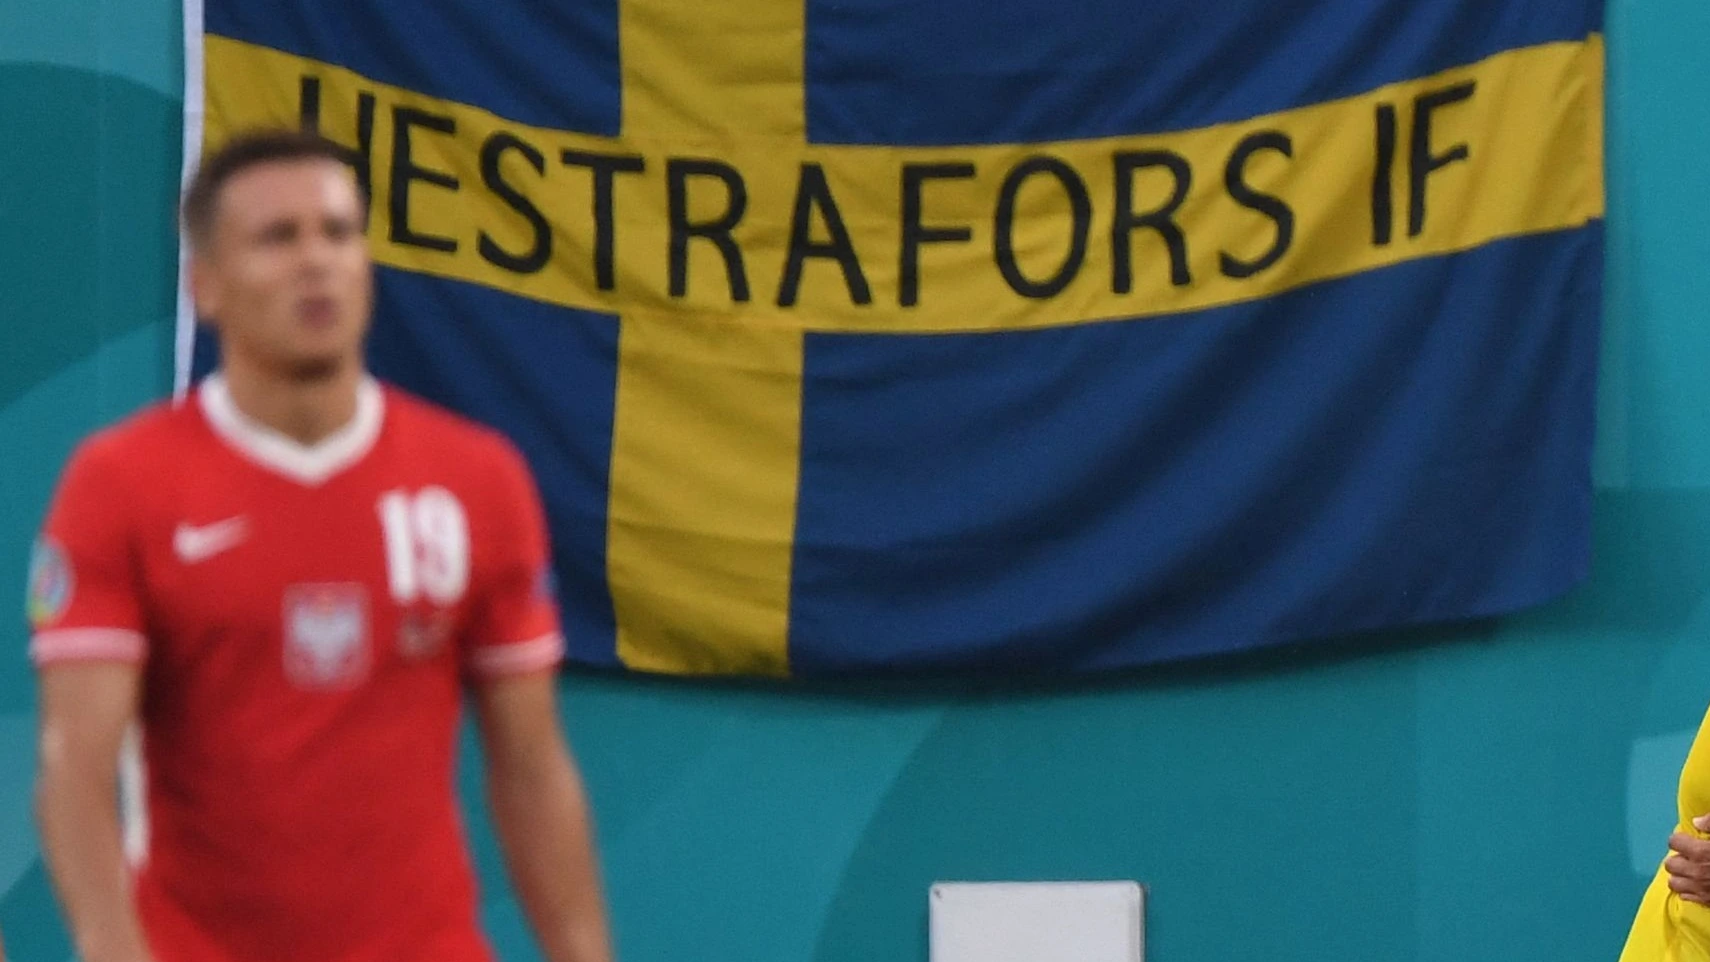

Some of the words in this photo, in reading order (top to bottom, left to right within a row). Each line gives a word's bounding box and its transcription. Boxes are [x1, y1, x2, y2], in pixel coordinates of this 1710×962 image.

[299, 76, 1294, 308] HESTRAFORS
[1368, 80, 1477, 246] IF
[376, 485, 471, 606] 19
